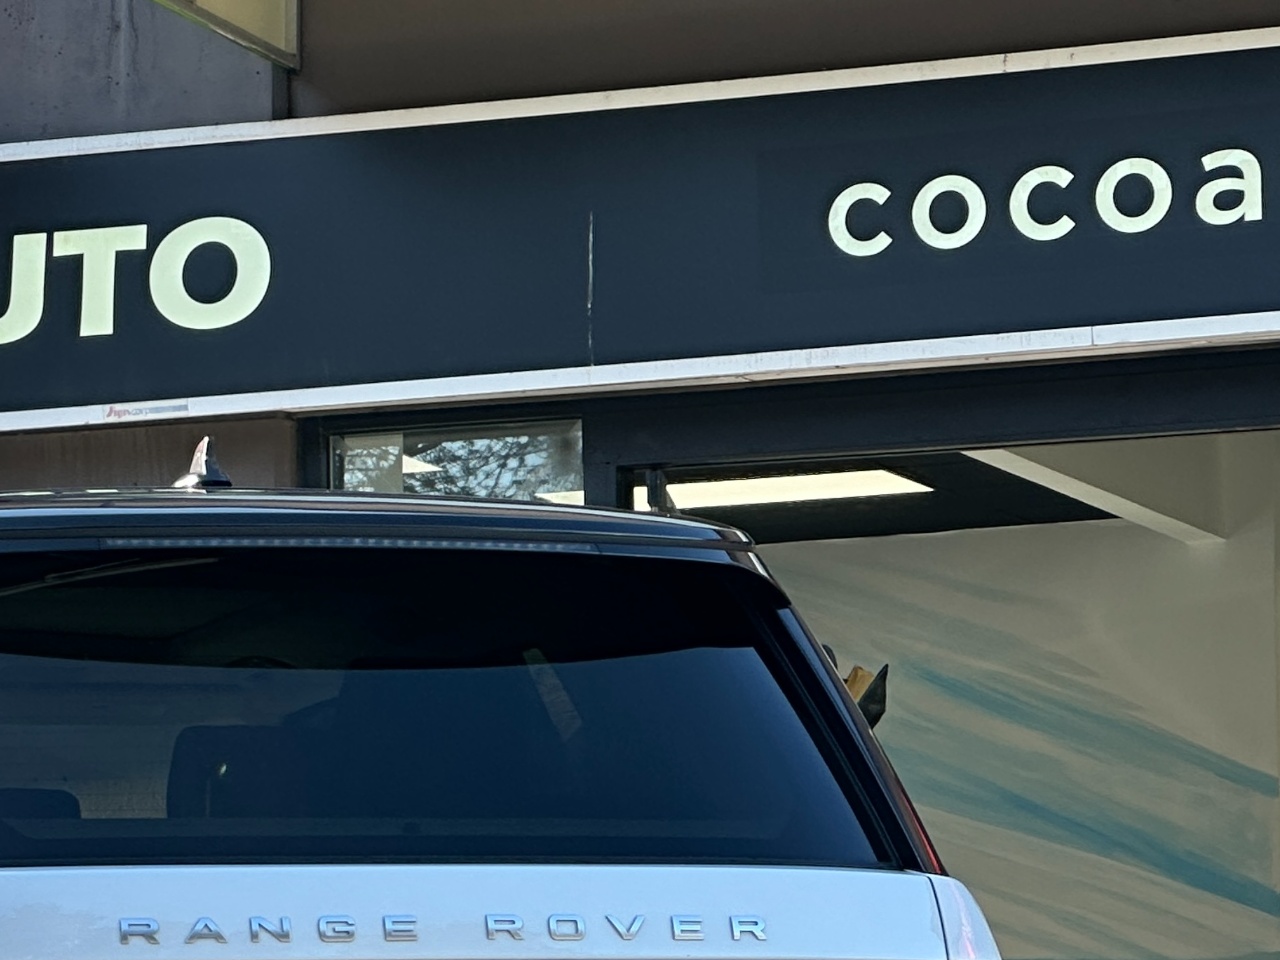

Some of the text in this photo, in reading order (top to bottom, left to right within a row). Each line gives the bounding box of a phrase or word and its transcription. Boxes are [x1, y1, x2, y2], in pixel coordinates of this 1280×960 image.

[828, 148, 1263, 257] cocoa
[119, 913, 768, 944] RANGE ROVER
